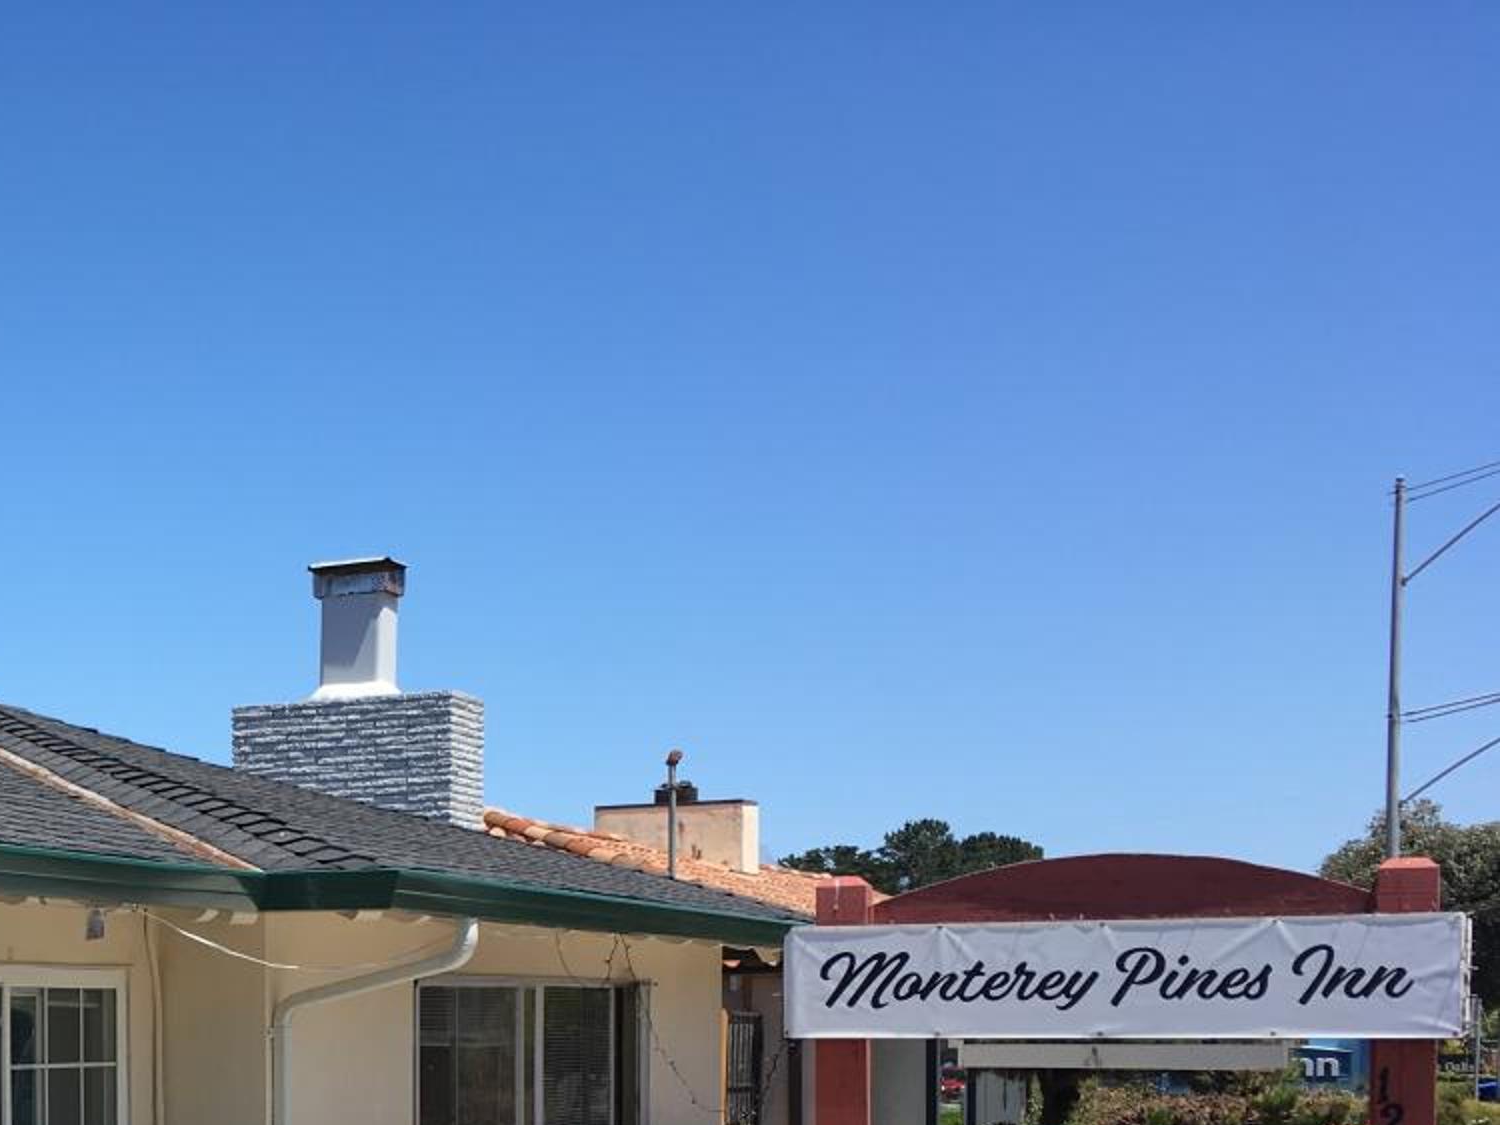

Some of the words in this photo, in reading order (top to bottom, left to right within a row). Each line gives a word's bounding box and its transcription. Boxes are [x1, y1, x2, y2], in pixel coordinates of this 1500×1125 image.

[819, 951, 1100, 1011] Monterey
[1110, 946, 1273, 1007] Pines
[1291, 944, 1415, 1006] Inn
[1291, 1056, 1340, 1077] nn
